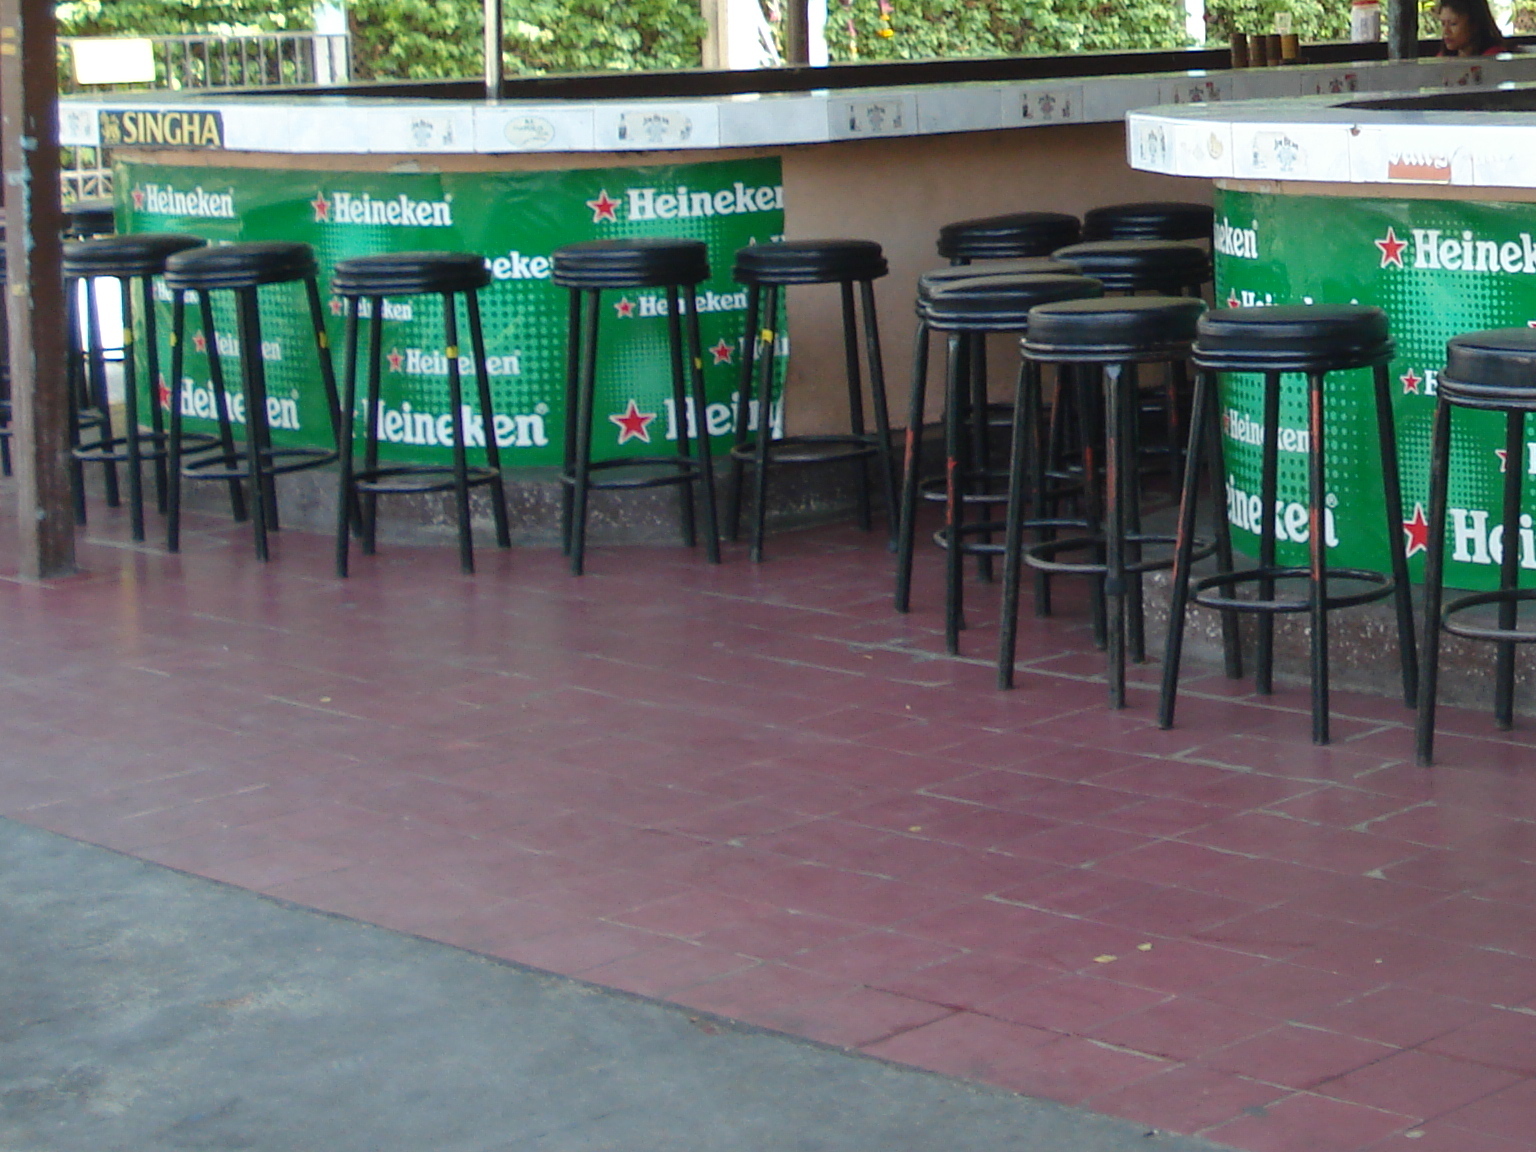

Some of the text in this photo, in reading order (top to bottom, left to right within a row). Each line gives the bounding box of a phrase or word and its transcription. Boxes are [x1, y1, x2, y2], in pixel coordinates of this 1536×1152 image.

[122, 111, 222, 146] SINGHA
[145, 184, 235, 218] Heineken
[333, 193, 453, 227] Heineken
